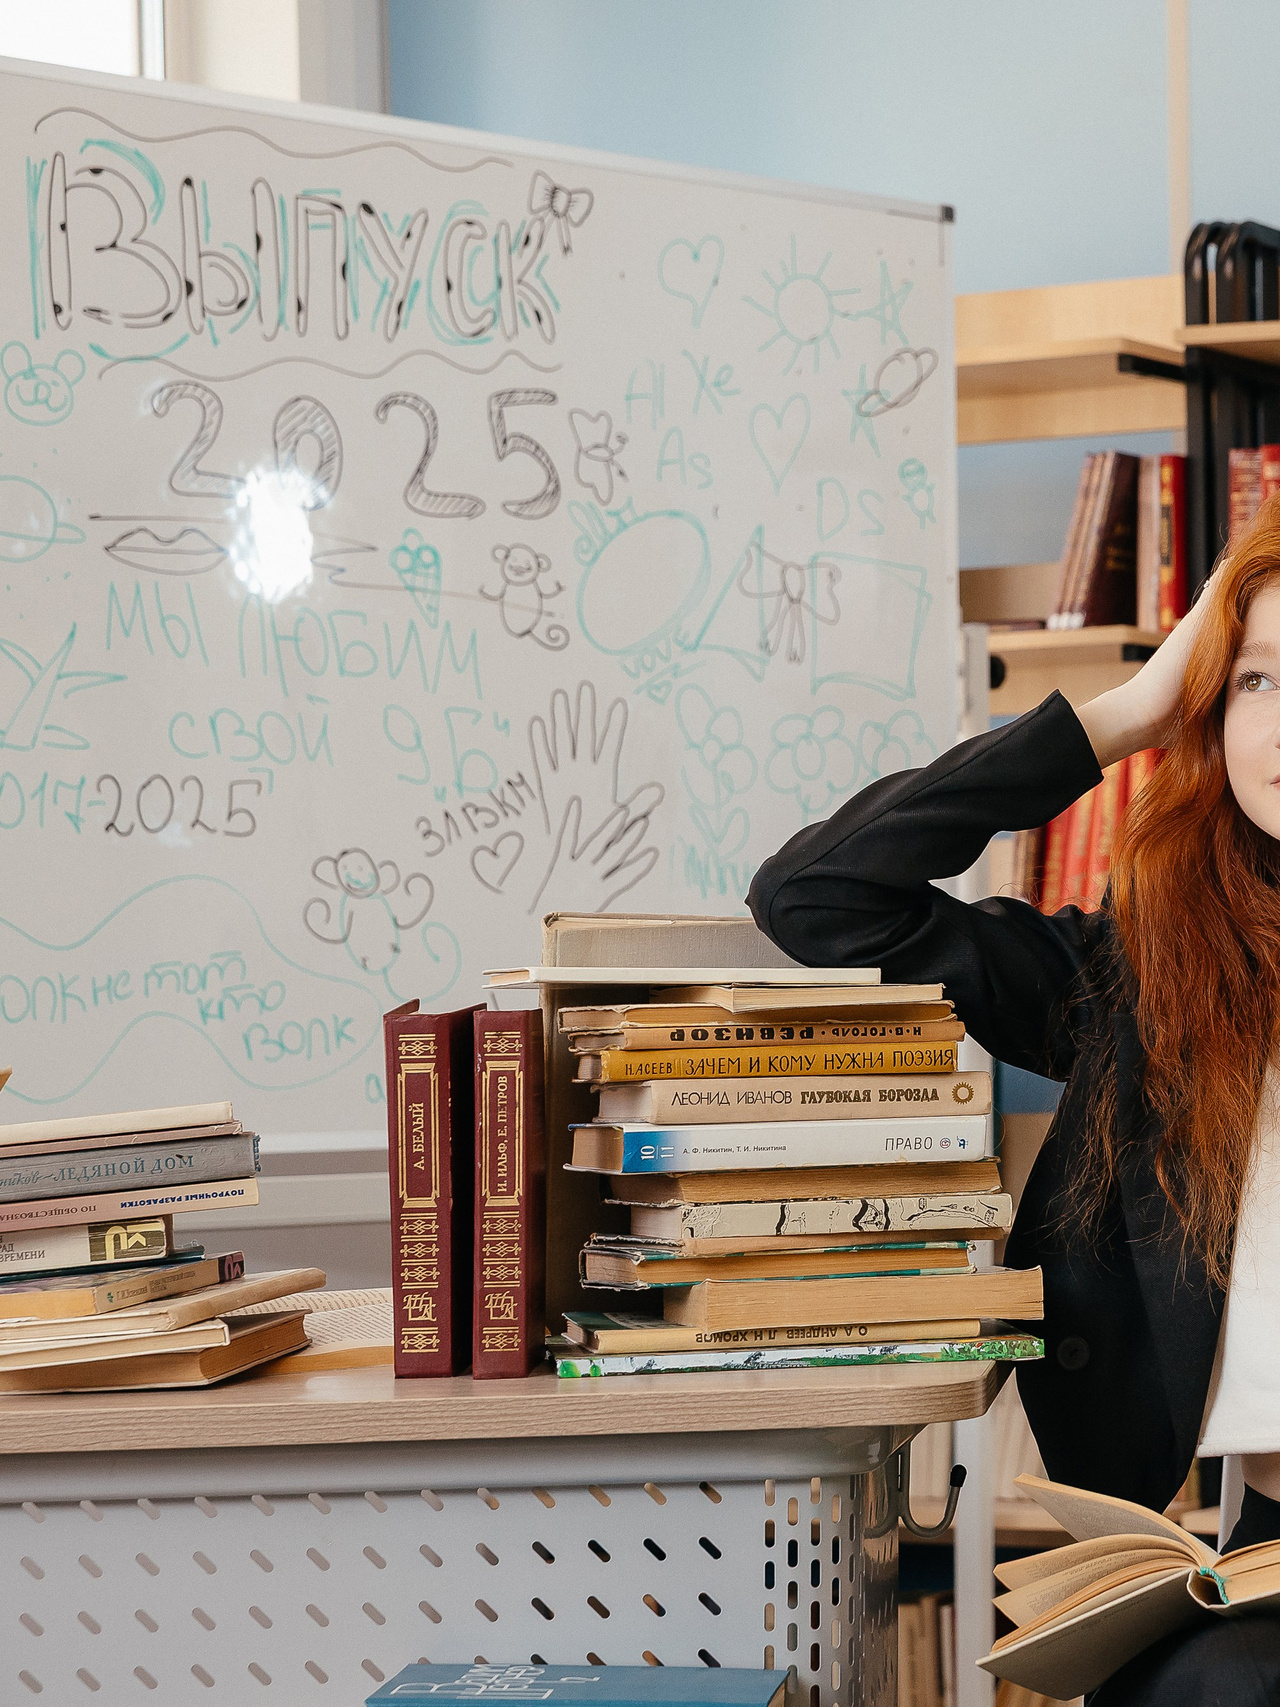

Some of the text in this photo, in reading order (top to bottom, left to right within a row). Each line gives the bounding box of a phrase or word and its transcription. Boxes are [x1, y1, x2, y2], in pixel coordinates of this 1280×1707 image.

[40, 148, 558, 344] ВЫПУСК
[150, 381, 561, 520] 2025
[105, 581, 484, 699] МЫ ЛЮБИМ
[169, 694, 334, 767] СВОЙ
[669, 1026, 814, 1041] РЕВИЗОР
[685, 1057, 741, 1075] ЗАЧЕМ
[749, 1056, 760, 1073] И
[768, 1054, 816, 1072] КОМУ
[824, 1051, 884, 1070] НУЖНА
[893, 1049, 954, 1067] ПОЭЗИЯ
[498, 1075, 509, 1123] ПЕТРОВ
[671, 1088, 940, 1106] ЛЕОНИД ИВАНОВ ГЛУБОКАЯ БОРОЗДА
[408, 1101, 425, 1172] А. БЕЛЫЙ
[885, 1136, 933, 1151] ПРАВО
[53, 1157, 147, 1183] ЛЕДЯНОЙ
[151, 1154, 194, 1176] ДОМ
[81, 1204, 97, 1214] ПО
[120, 1195, 183, 1209] РАЗРАБОТКИ
[185, 1189, 245, 1204] ПОУРОЧНЫЕ
